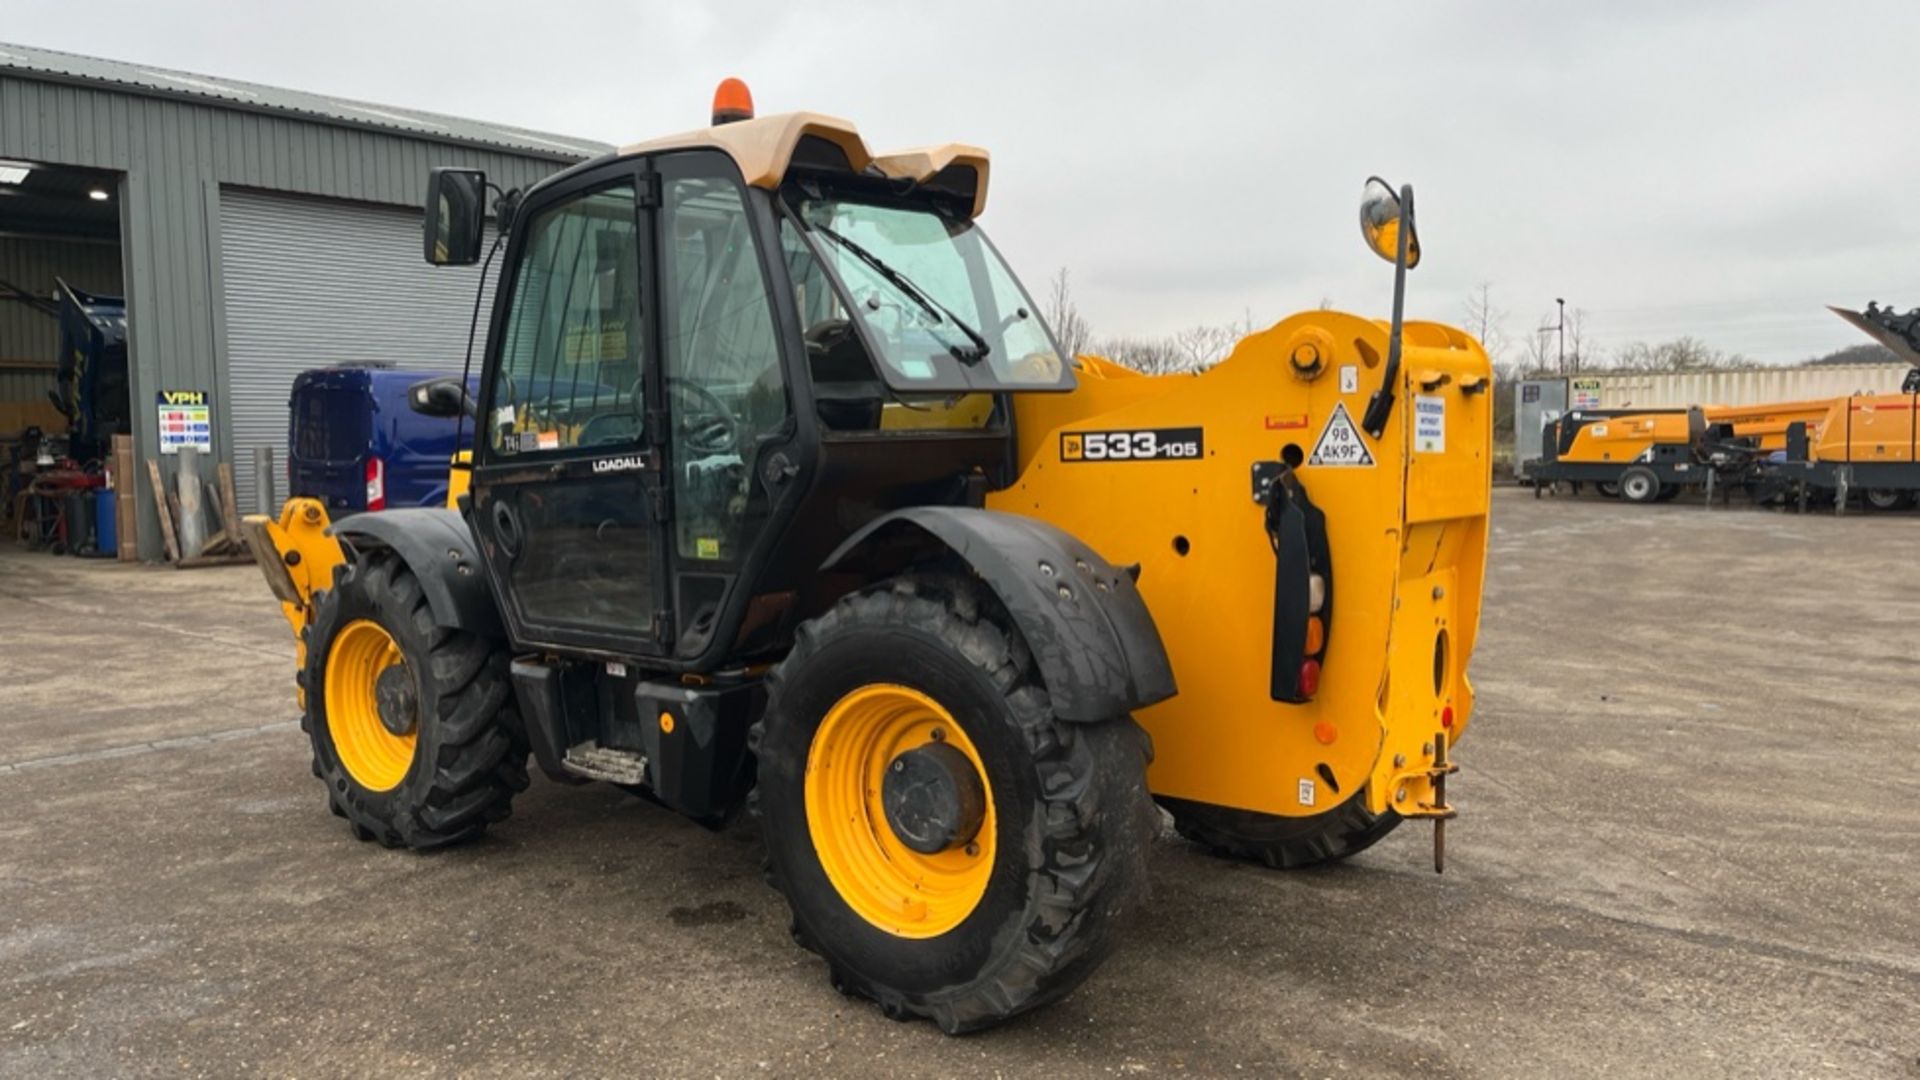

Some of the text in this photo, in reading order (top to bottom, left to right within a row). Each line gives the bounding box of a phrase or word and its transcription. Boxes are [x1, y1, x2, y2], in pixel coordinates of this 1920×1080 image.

[163, 391, 203, 405] VPH
[1332, 428, 1349, 441] 98
[1323, 444, 1359, 459] AK9F
[592, 456, 645, 472] LOADALL
